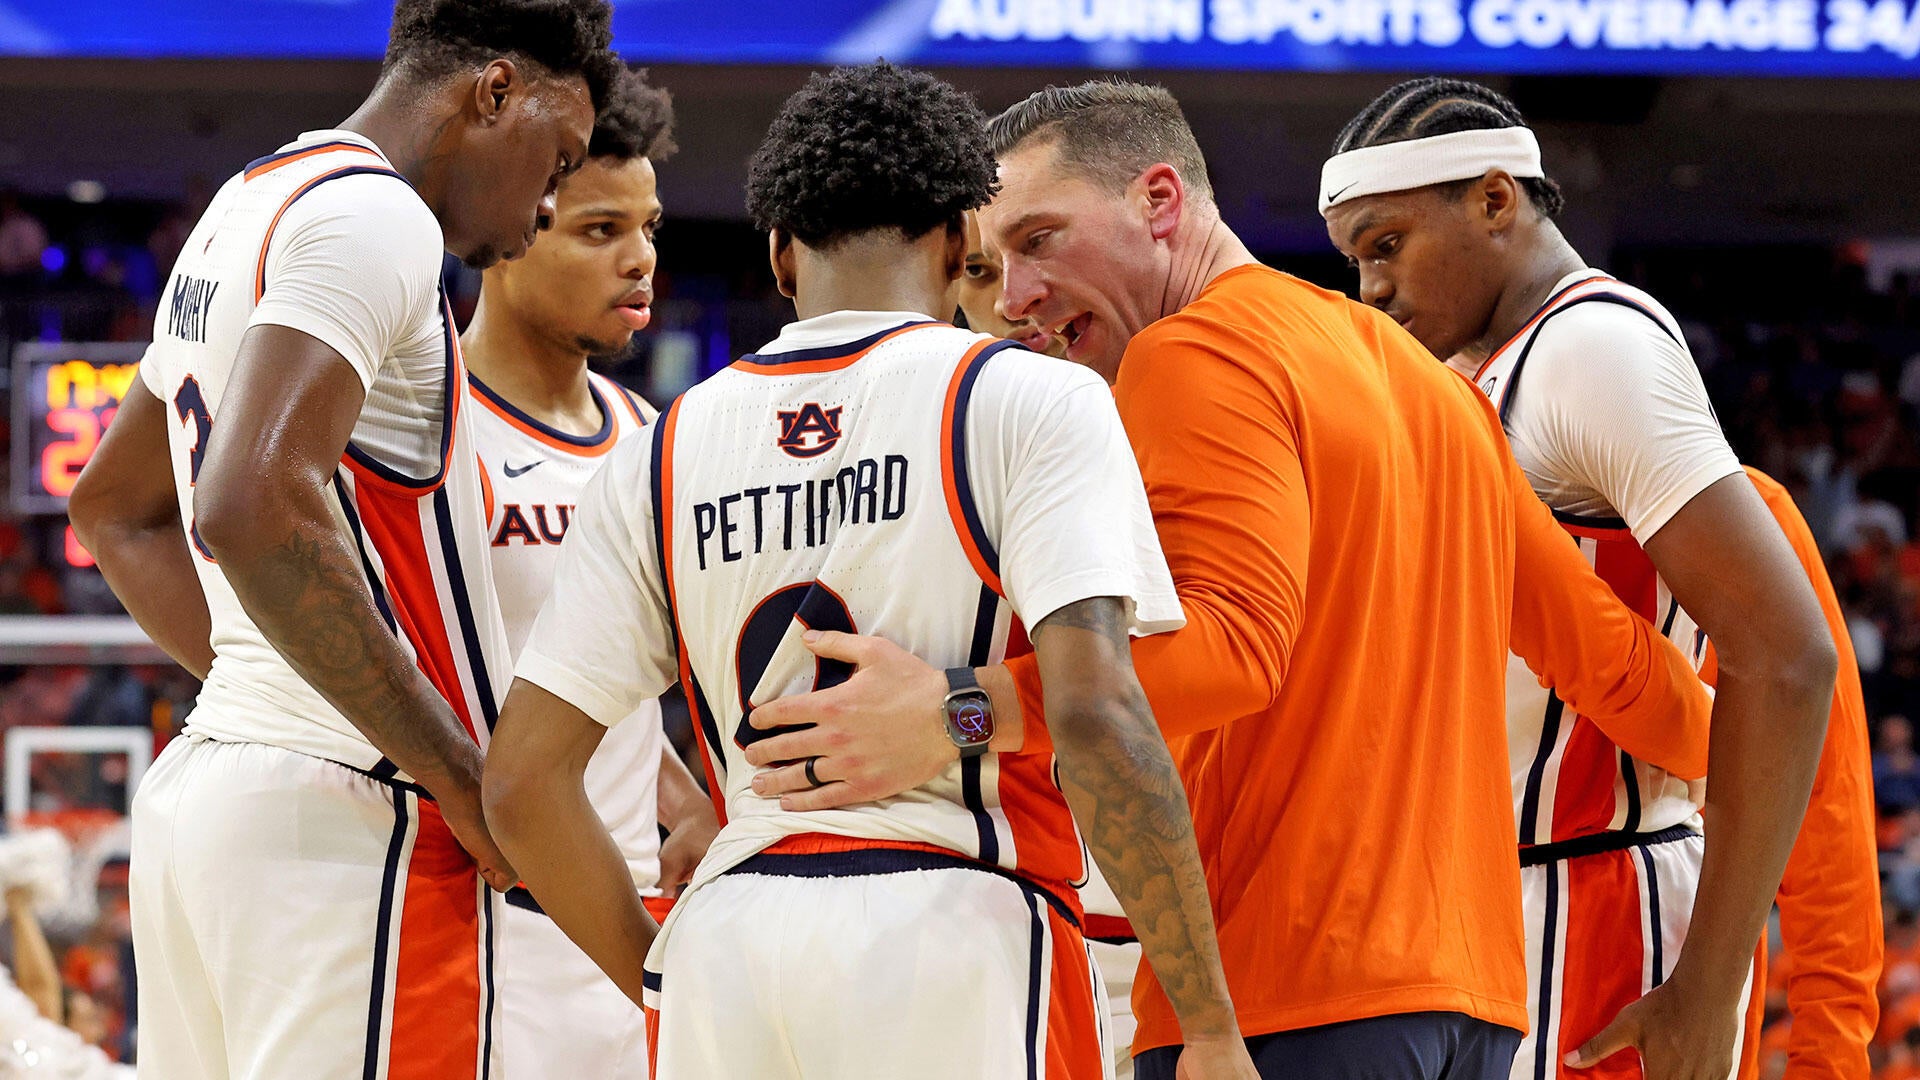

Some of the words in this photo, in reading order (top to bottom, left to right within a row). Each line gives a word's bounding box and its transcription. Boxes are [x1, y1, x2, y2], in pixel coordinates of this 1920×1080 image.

[931, 0, 1203, 42] AUBURN
[1208, 0, 1464, 46] SPORTS
[1469, 0, 1819, 51] COVERAGE
[693, 454, 908, 571] PETTIFORD
